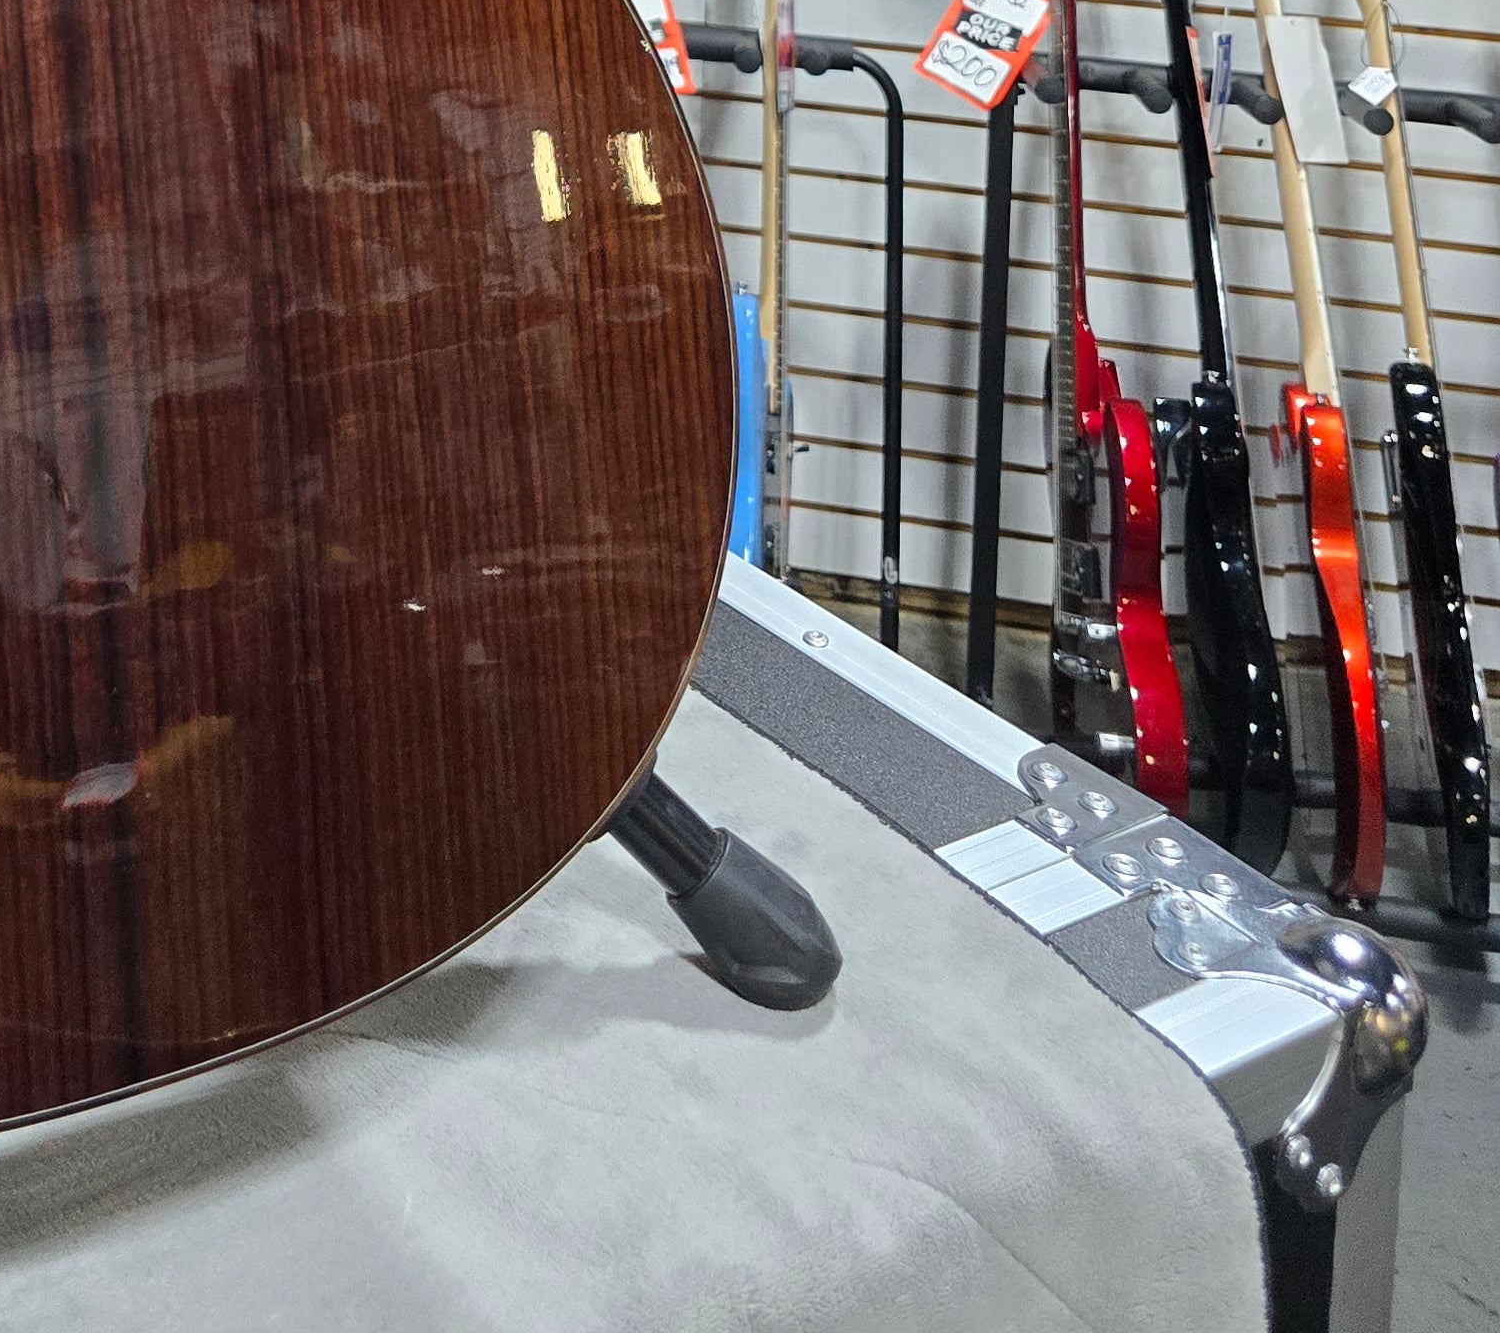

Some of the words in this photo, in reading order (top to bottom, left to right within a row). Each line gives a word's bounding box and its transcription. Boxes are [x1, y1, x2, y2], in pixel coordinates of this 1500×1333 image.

[956, 20, 1018, 51] PRICE
[969, 13, 1011, 35] OUR
[931, 39, 998, 87] $200
